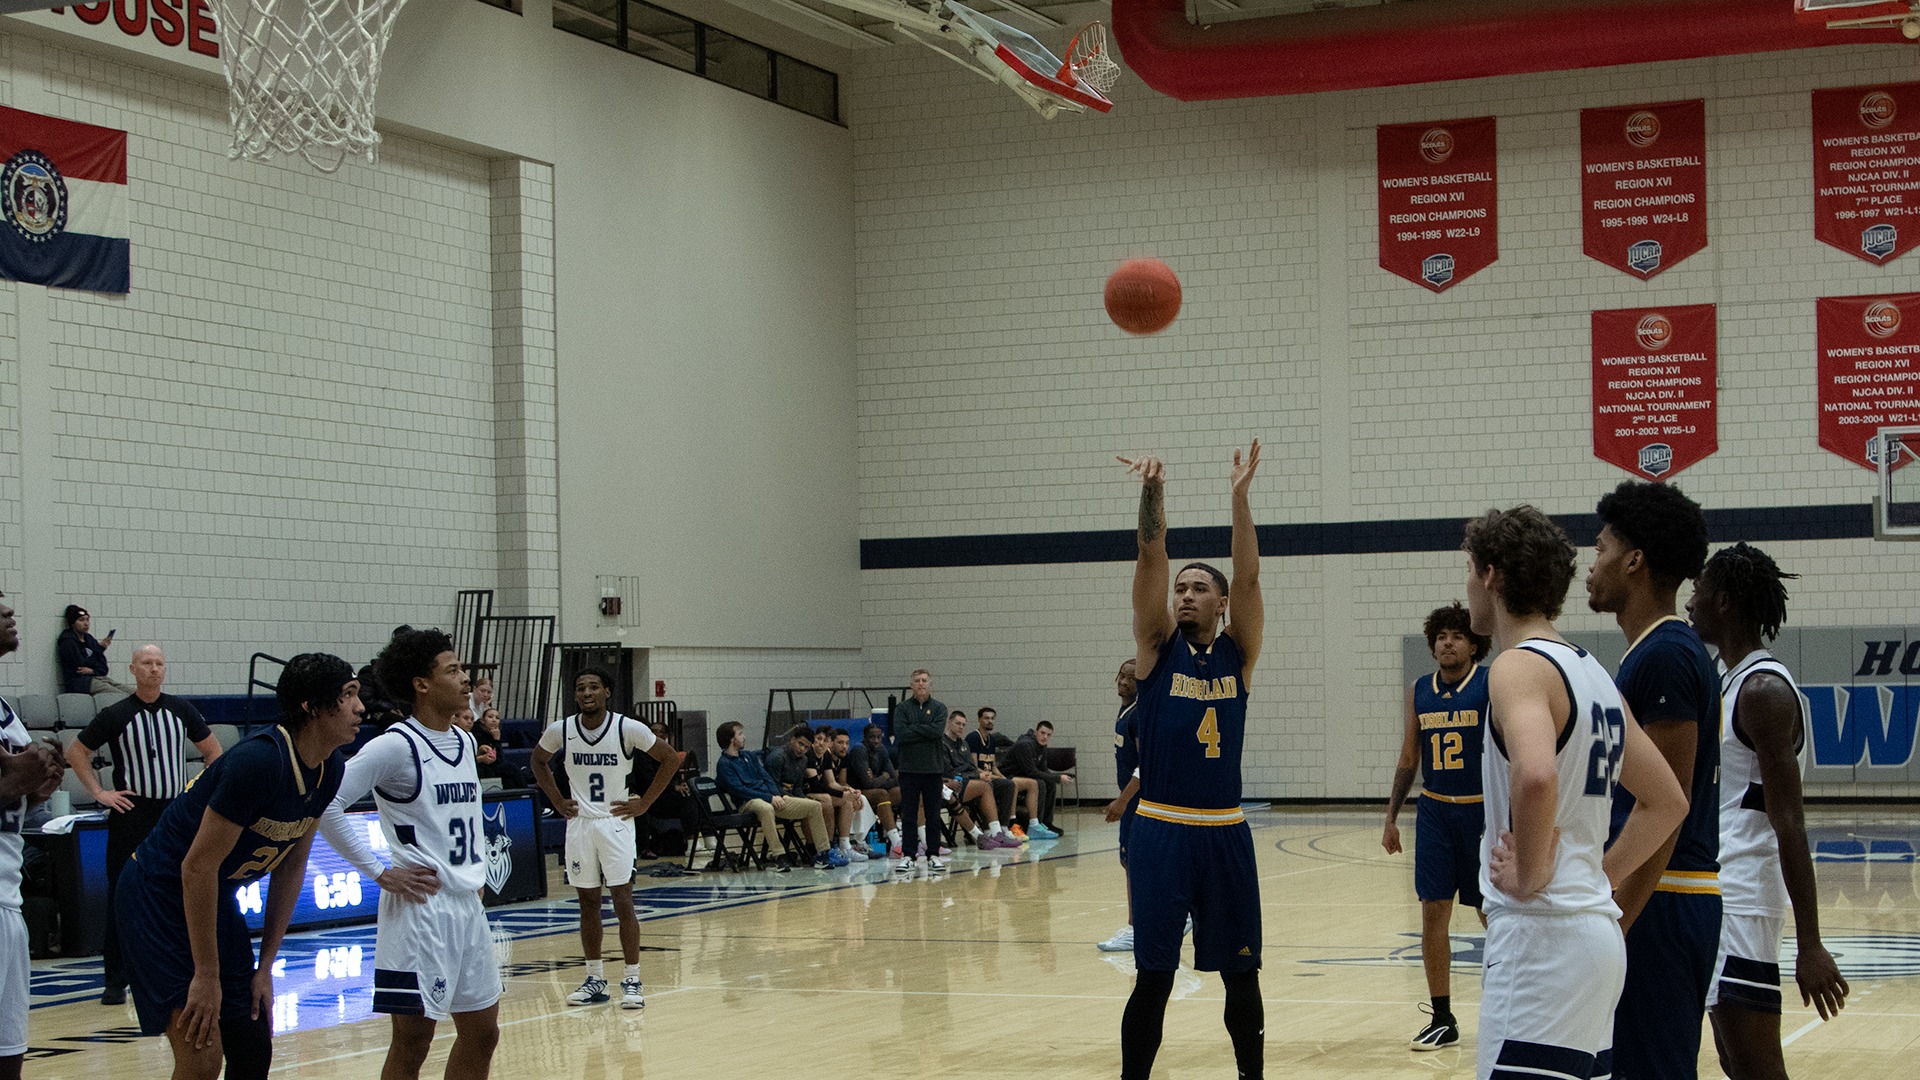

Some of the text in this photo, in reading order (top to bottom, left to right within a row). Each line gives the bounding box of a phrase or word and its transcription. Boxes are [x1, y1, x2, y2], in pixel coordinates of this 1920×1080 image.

[1823, 136, 1870, 147] WOMEN'S
[1850, 146, 1906, 157] REGION XVI
[1586, 156, 1701, 174] WOMEN'S BASKETBALL
[1829, 161, 1867, 171] REGION
[1382, 172, 1493, 189] WOMEN'S BASKETBALL
[1848, 169, 1909, 182] NJCAA DIV. II
[1615, 176, 1672, 190] REGION XVI
[1820, 182, 1920, 197] NATIONAL TOURNAM
[1410, 192, 1465, 205] REGION XVI
[1593, 193, 1695, 210] REGION CHAMPIONS
[1870, 195, 1902, 205] PLACE
[1389, 208, 1487, 224] REGION CHAMPIONS
[1600, 213, 1689, 228] 1995-1996 W24-L8
[1835, 208, 1880, 220] 1996-1997
[1396, 226, 1481, 242] 1994-1995 W22-L9
[1862, 229, 1897, 250] NJCAA
[1628, 245, 1662, 265] NJCAA
[1422, 258, 1455, 279] NJCAA
[1864, 315, 1892, 323] Scouts
[1637, 328, 1663, 336] Scouts
[1601, 353, 1708, 366] WOMEN'S BASKETBALL
[1827, 347, 1874, 358] WOMEN'S
[1628, 366, 1681, 376] REGION XVI
[1855, 359, 1910, 370] REGION XVI
[1608, 377, 1701, 390] REGION CHAMPIONS
[1834, 372, 1920, 384] REGION CHAMPIO
[1625, 390, 1684, 400] NJCAA DIV. II
[1852, 386, 1914, 397] NJCAA DIV. II
[1599, 400, 1711, 414] NATIONAL TOURNAMENT
[1824, 401, 1872, 412] NATIONAL
[1632, 414, 1678, 424] 2ND PLACE
[1838, 414, 1884, 425] 2003-2004
[1615, 425, 1696, 437] 2001-2002 W25-L9
[1639, 449, 1672, 467] NJCAA
[1169, 672, 1237, 701] HIGHLAND
[1196, 706, 1221, 758] 4
[1430, 731, 1464, 770] 12
[1583, 700, 1625, 800] 22
[572, 752, 618, 766] WOLVES
[434, 782, 477, 805] WOLVE
[589, 772, 605, 803] 2
[449, 816, 483, 866] 31
[313, 871, 362, 910] 6:56
